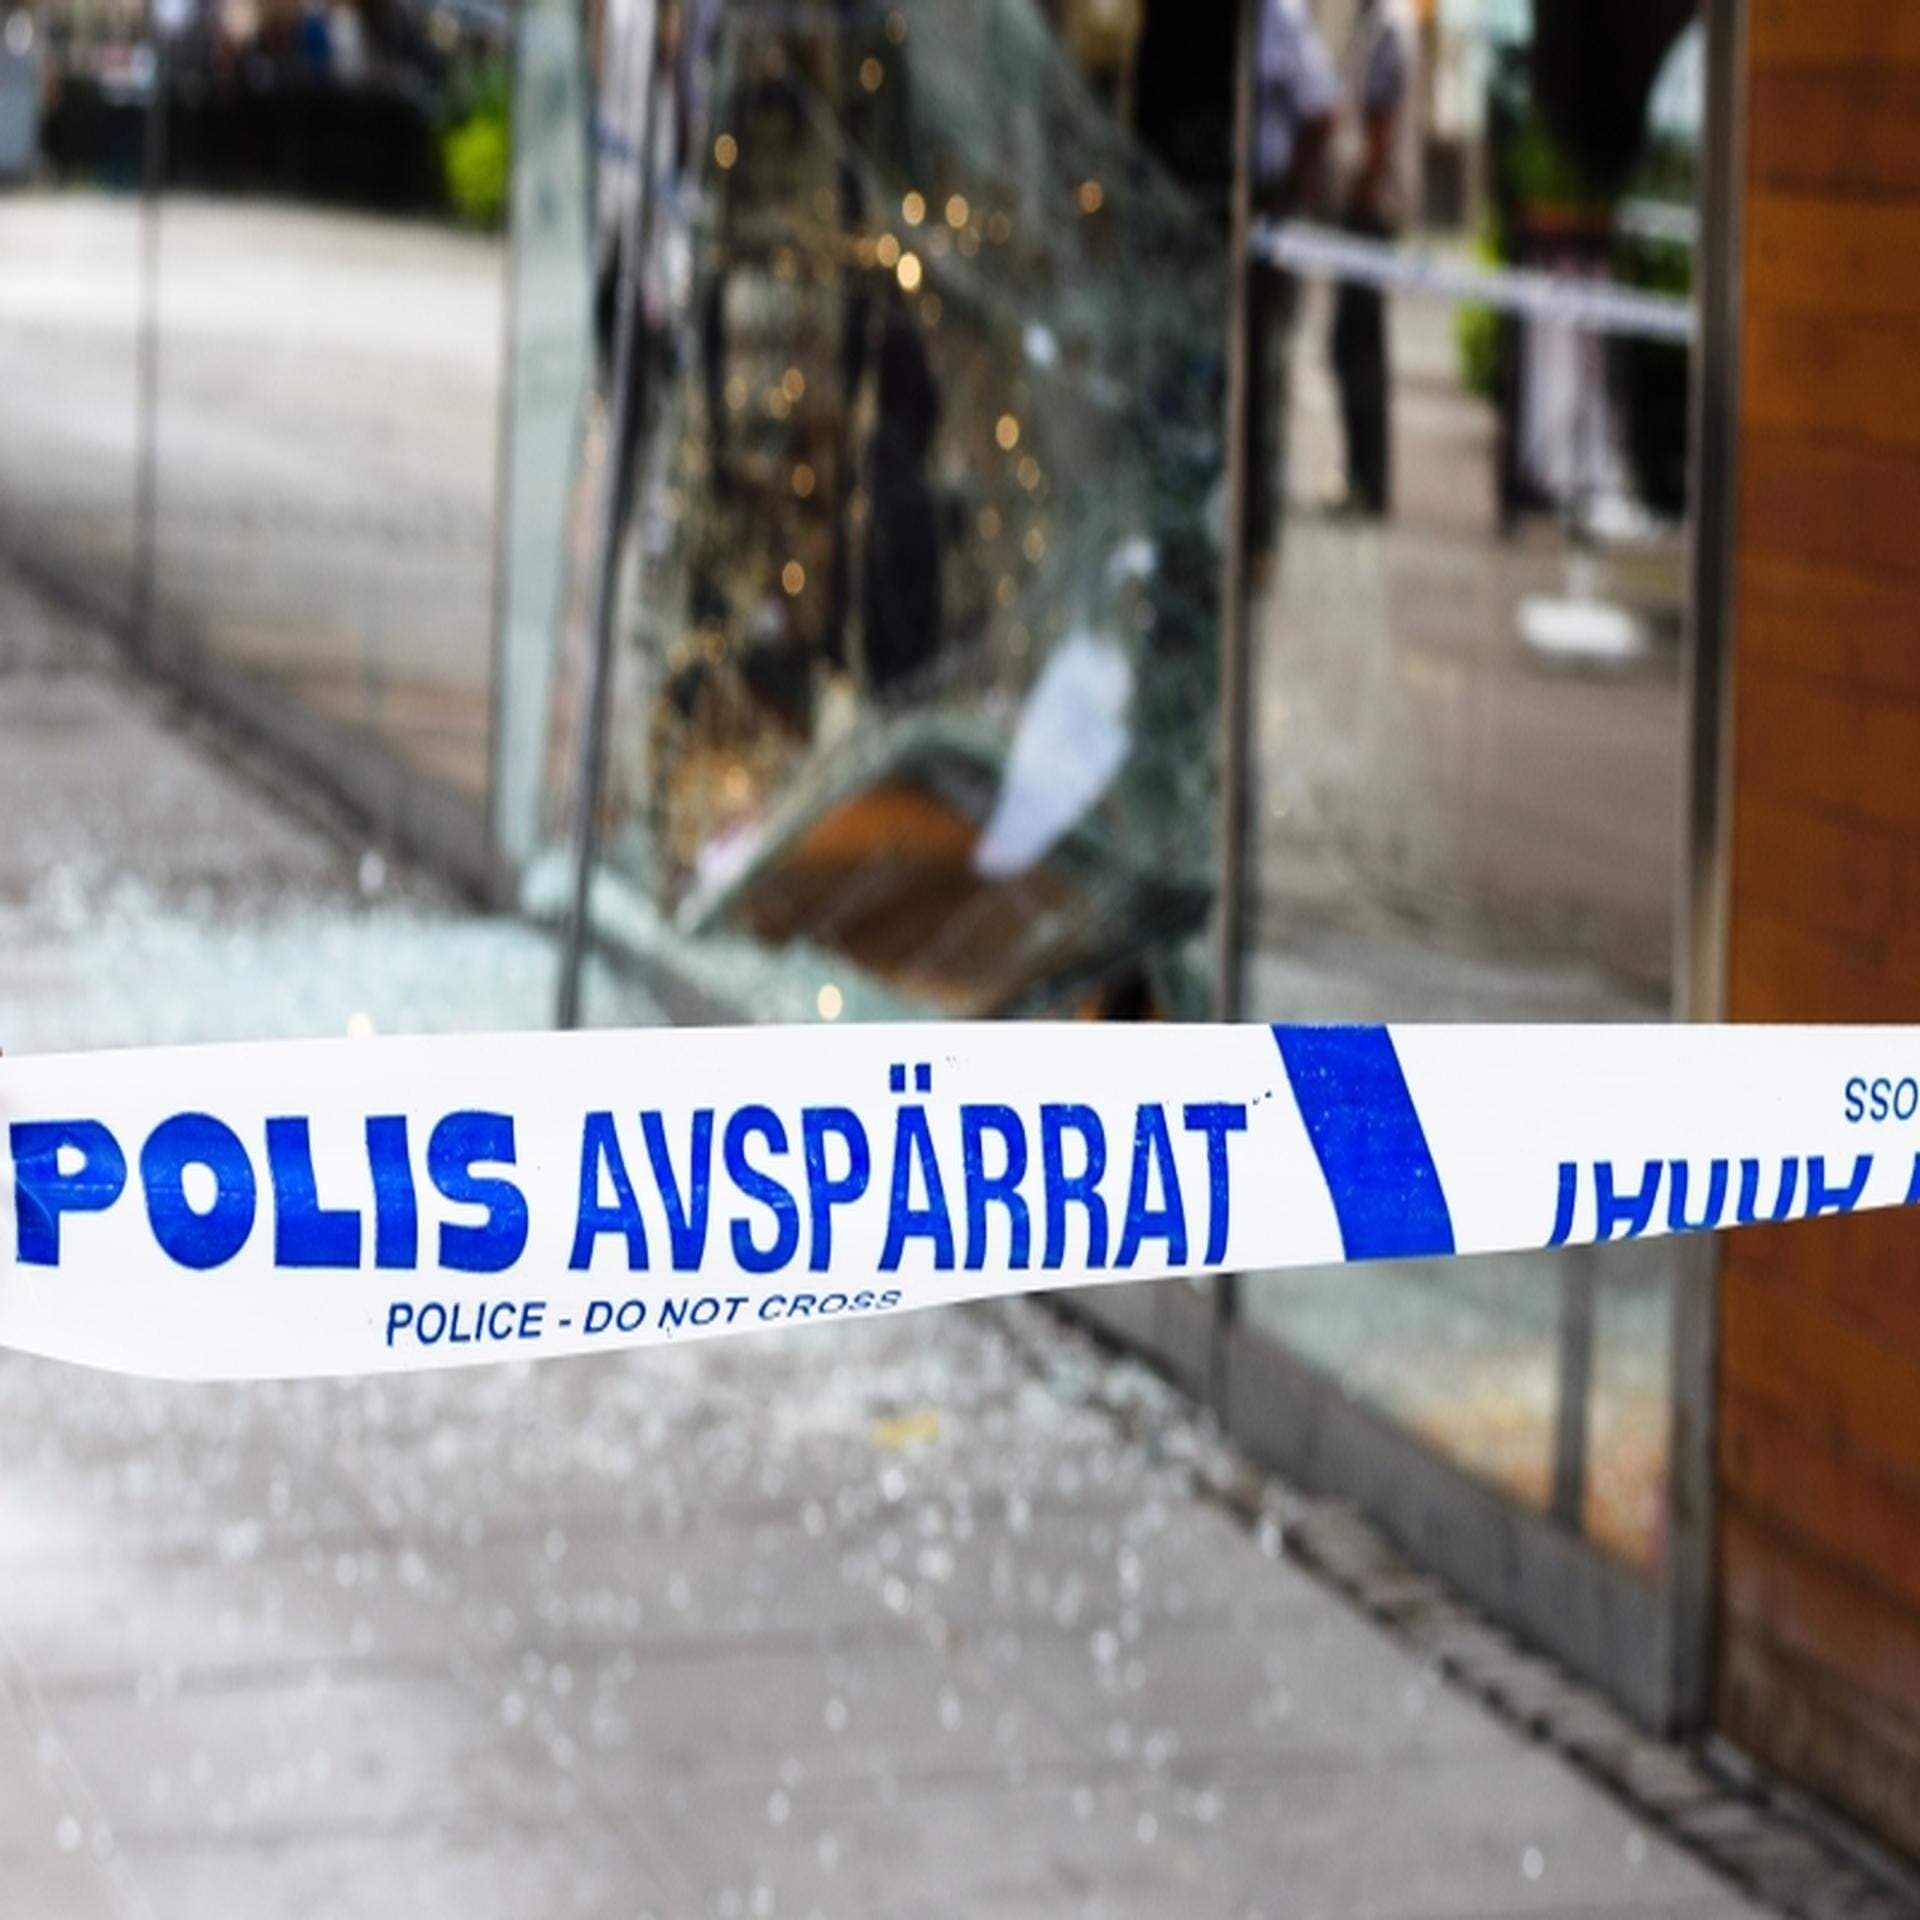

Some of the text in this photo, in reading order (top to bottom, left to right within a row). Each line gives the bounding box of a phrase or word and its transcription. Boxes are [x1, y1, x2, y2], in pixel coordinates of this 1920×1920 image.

[8, 1062, 1249, 1276] POLIS AVSPÄRRAT
[385, 1301, 545, 1347] POLICE
[583, 1299, 646, 1335] DO
[657, 1296, 749, 1330] NOT
[757, 1291, 903, 1321] CROSS
